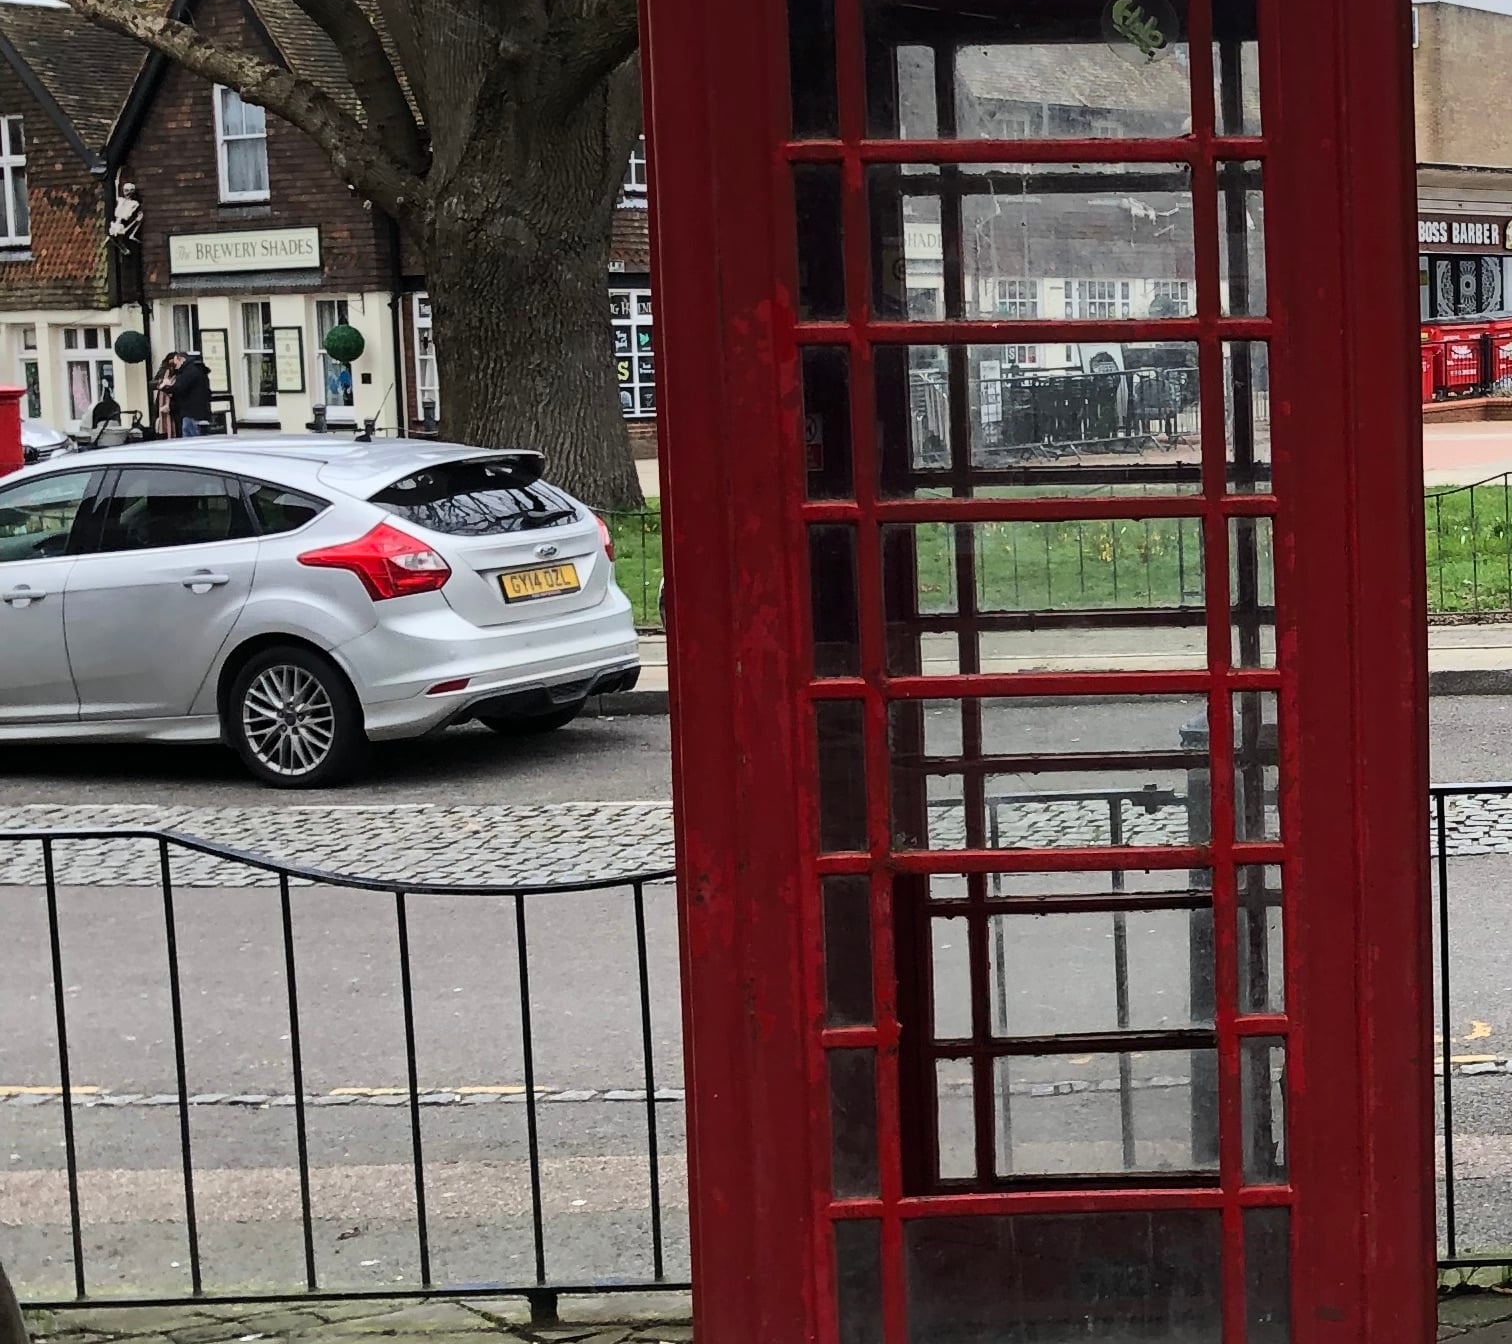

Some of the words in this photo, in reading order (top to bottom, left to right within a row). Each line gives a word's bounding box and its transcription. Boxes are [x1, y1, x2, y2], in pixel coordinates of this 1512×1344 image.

[1418, 220, 1447, 243] BOSS
[1452, 222, 1499, 245] BARBER
[195, 241, 258, 264] BREWERY
[260, 238, 314, 257] SHADES
[510, 572, 543, 594] GY14
